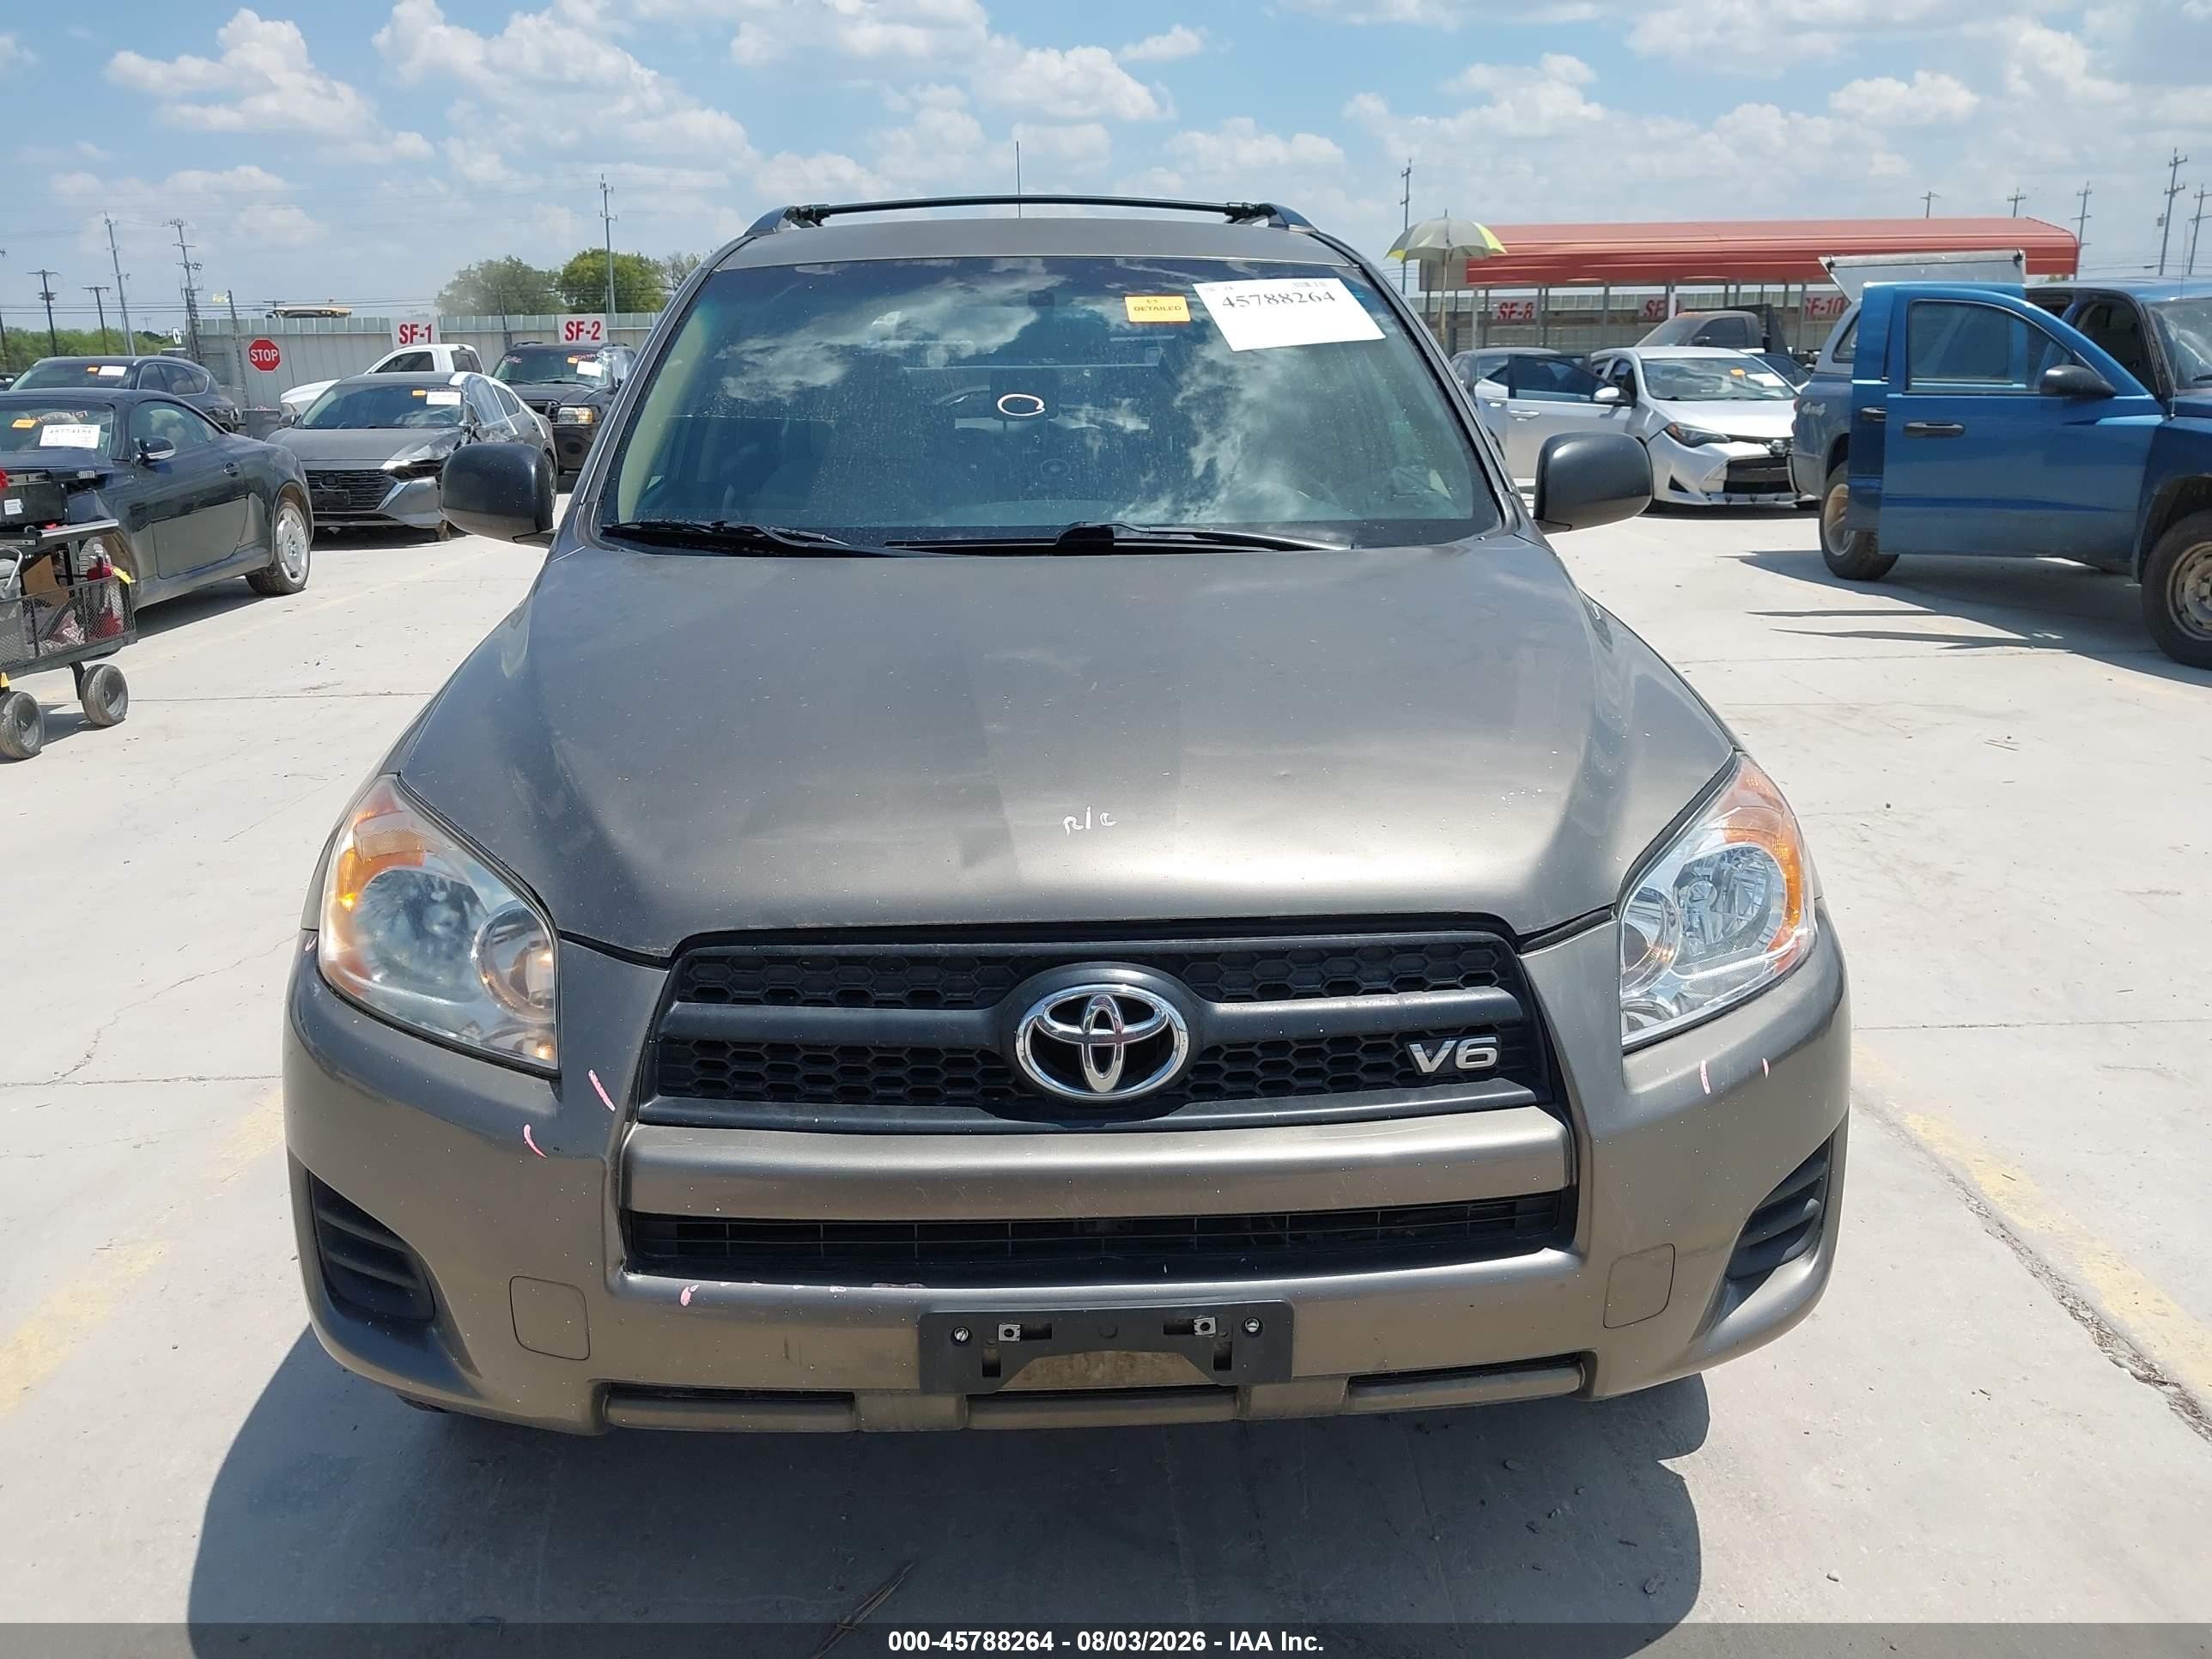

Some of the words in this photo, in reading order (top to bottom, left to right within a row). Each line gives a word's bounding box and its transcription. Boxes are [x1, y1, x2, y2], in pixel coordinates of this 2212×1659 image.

[1222, 291, 1336, 307] 45788264
[1498, 301, 1534, 320] SF-8
[398, 323, 433, 344] SF-1
[565, 320, 601, 342] SF-2
[250, 349, 278, 362] STOP
[1408, 1036, 1498, 1073] V6
